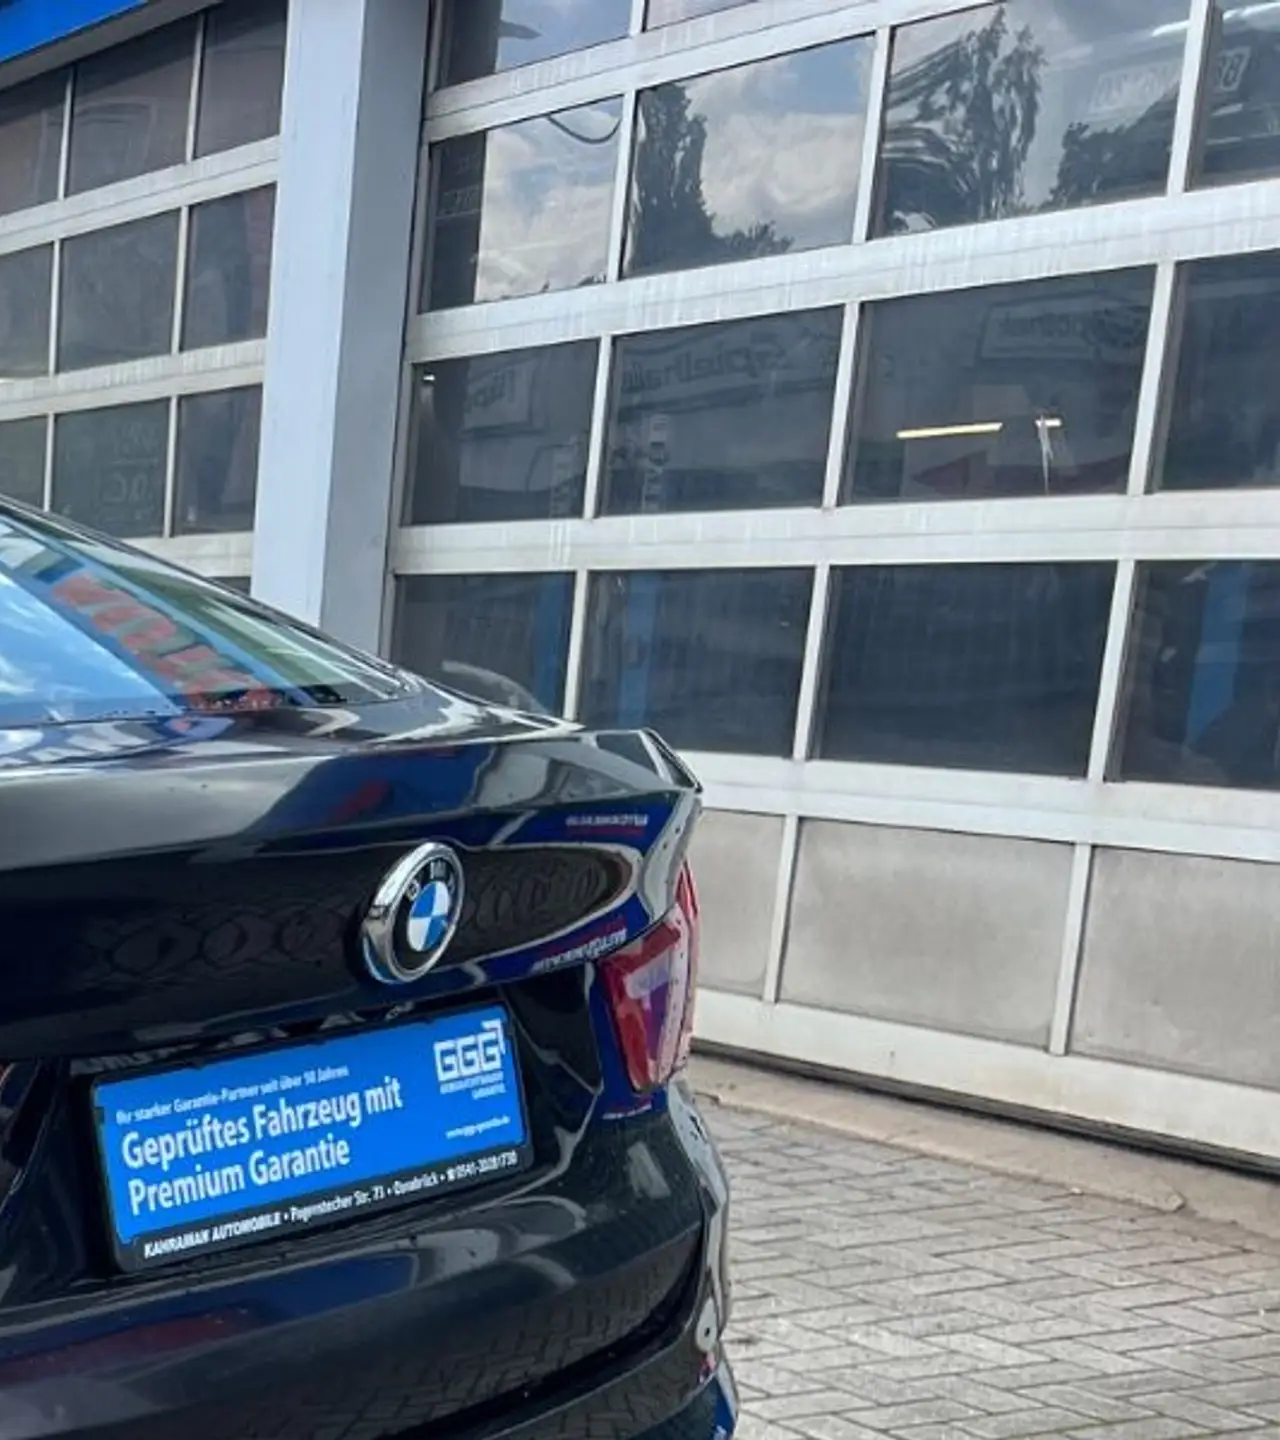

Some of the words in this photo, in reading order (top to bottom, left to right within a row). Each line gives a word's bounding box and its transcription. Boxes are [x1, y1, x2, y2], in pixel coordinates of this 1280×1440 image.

[434, 1021, 506, 1081] GGG
[122, 1110, 250, 1169] Geprüftes
[254, 1094, 361, 1140] Fahrzeug
[365, 1076, 404, 1115] mit
[128, 1164, 245, 1215] Premium
[249, 1137, 350, 1185] Garantie
[144, 1229, 211, 1260] KAHRAMAN
[212, 1211, 282, 1244] AUTOMOBILE
